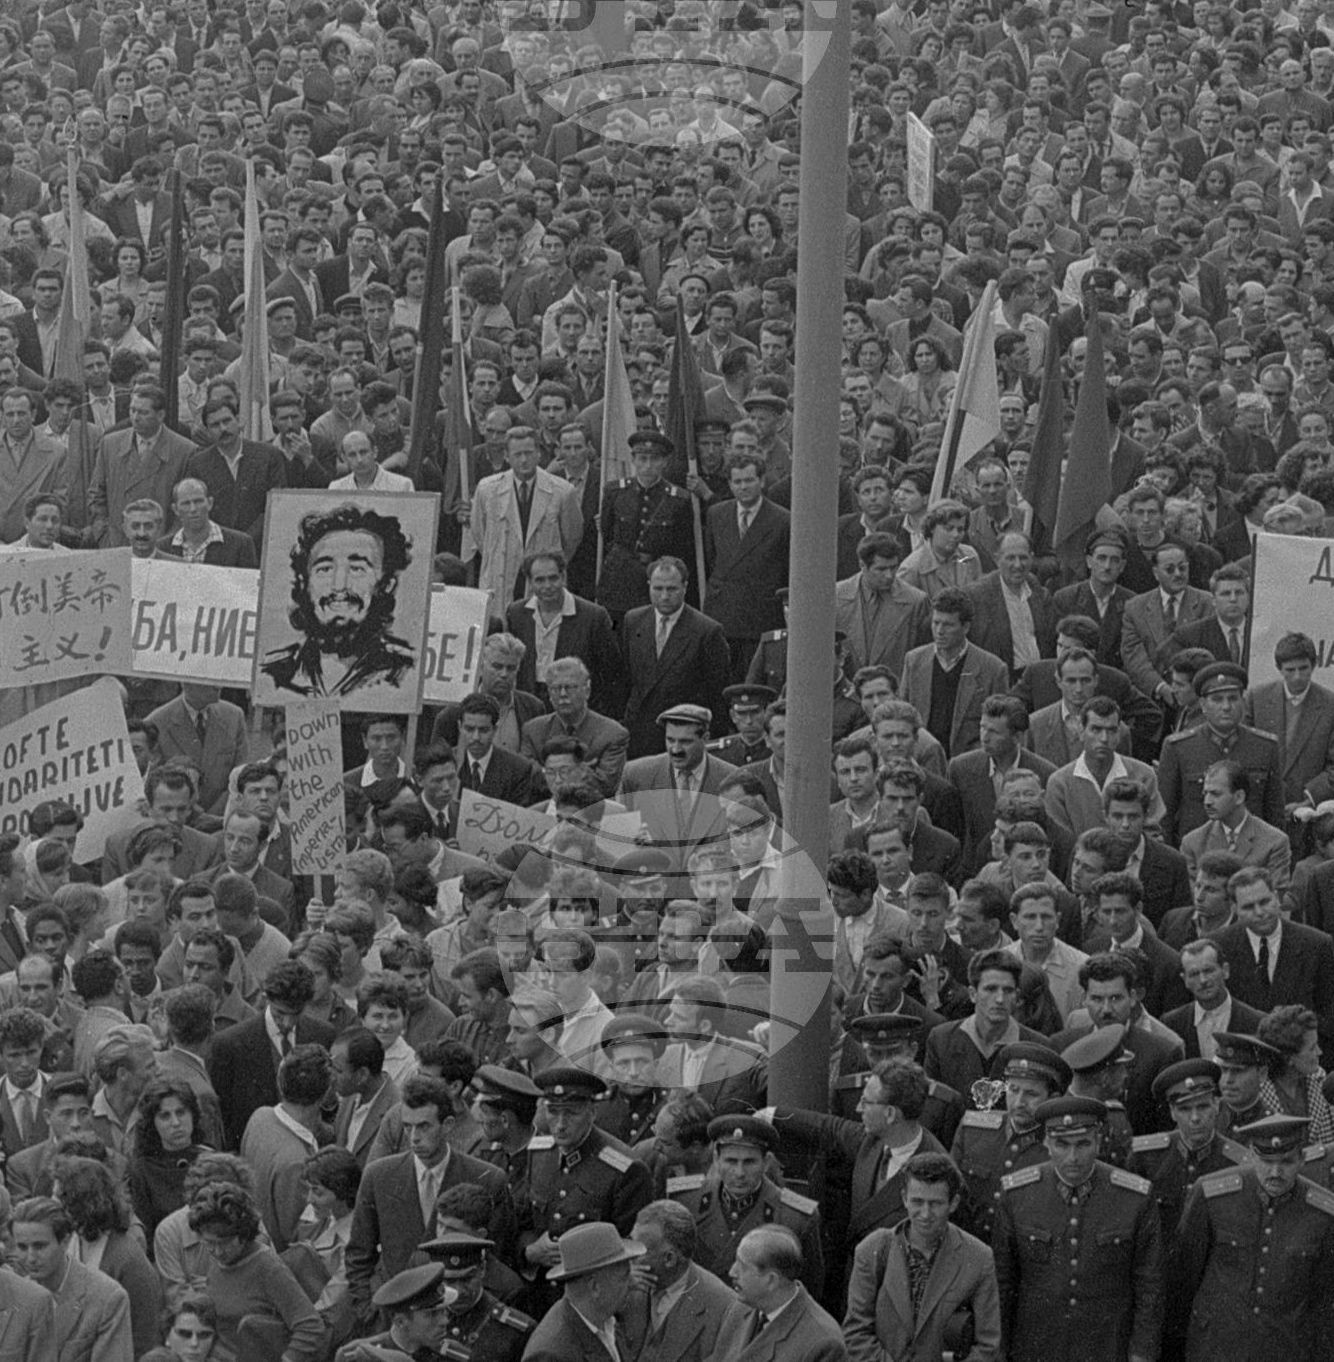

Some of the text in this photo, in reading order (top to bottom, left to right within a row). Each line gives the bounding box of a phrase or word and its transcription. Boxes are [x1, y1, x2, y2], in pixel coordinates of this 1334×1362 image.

[133, 600, 187, 661] БА,
[424, 626, 476, 683] БЕ!
[289, 743, 334, 771] with
[2, 776, 125, 838] POJVE
[289, 774, 324, 800] the
